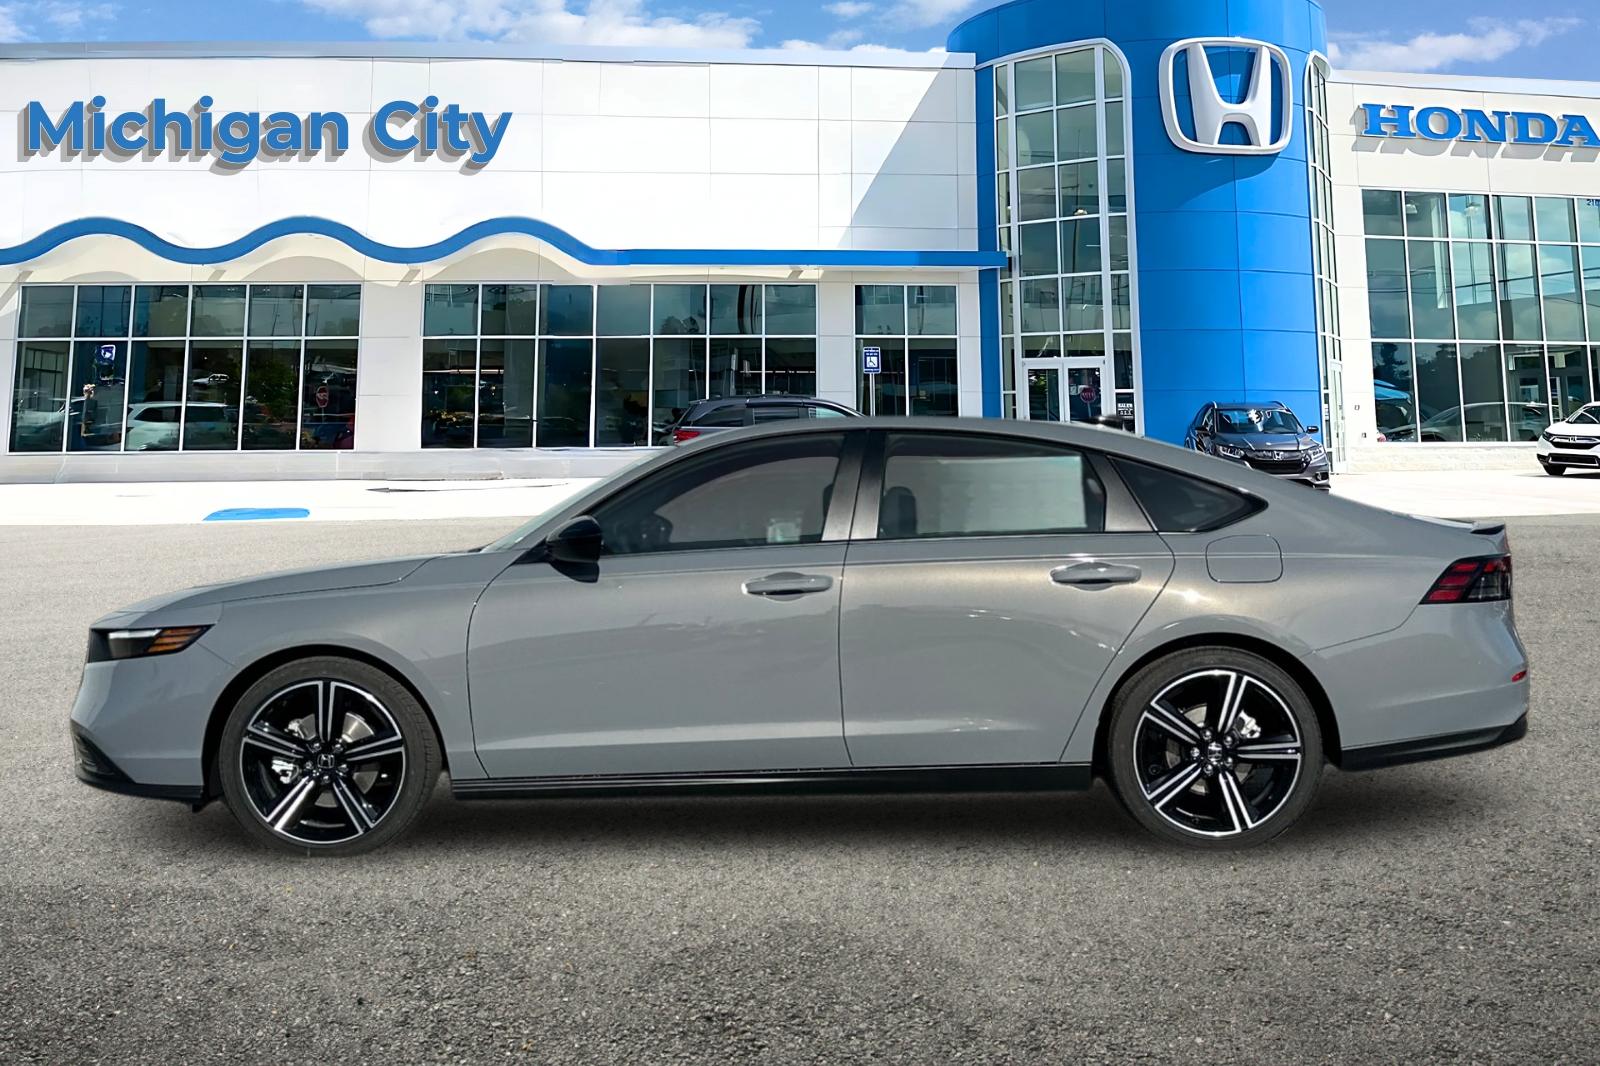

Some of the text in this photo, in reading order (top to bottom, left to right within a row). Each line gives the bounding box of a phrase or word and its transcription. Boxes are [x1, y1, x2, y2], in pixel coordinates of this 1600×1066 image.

[28, 95, 513, 164] Michigan City
[1361, 102, 1600, 147] HONDA
